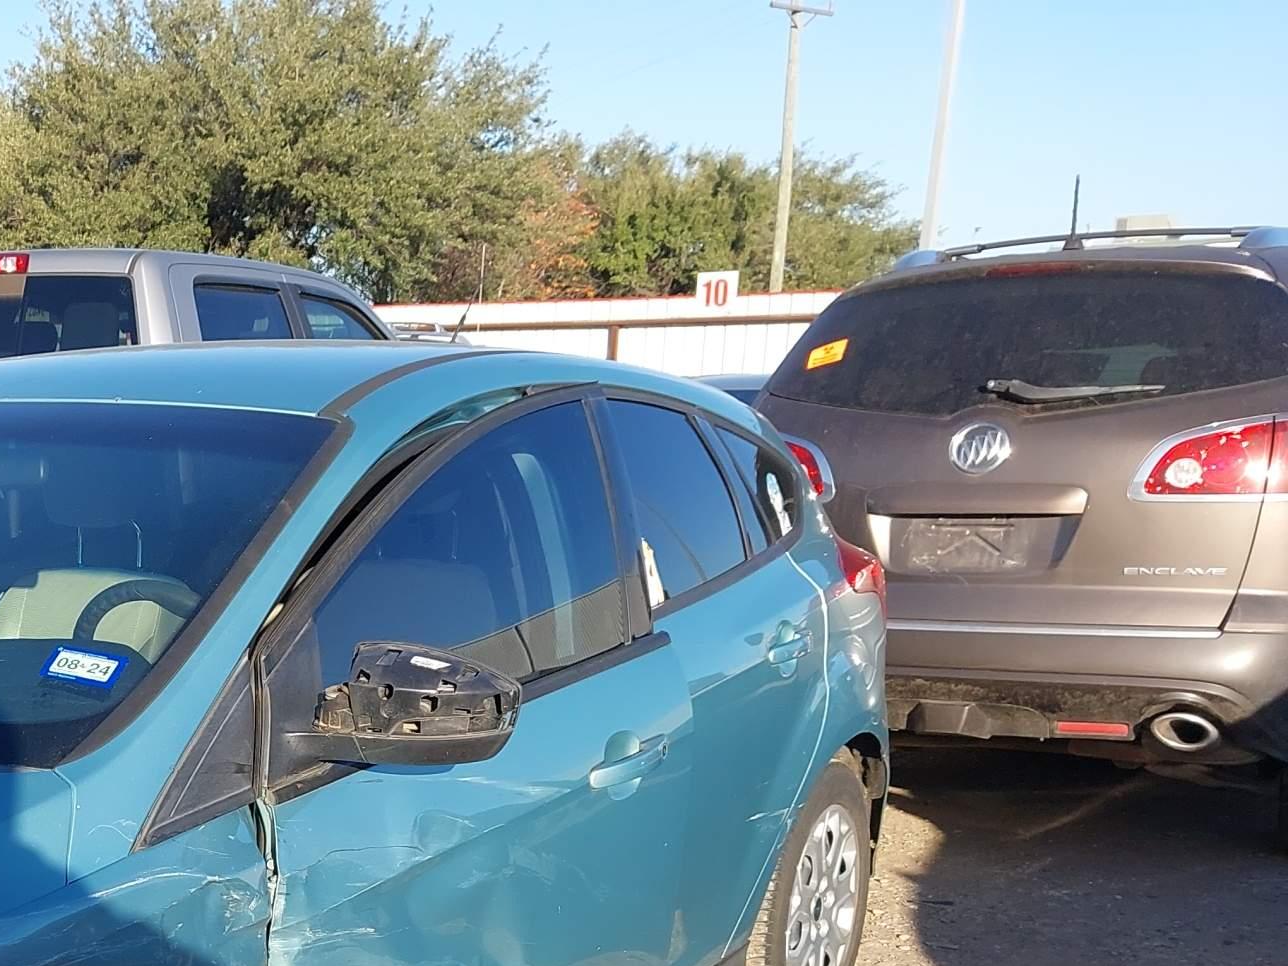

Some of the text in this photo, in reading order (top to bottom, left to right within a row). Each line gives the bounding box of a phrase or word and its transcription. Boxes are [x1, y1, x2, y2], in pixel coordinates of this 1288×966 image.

[702, 279, 729, 307] 10
[1123, 567, 1228, 576] ENCLAVE
[56, 657, 80, 670] 08
[86, 663, 111, 676] 24
